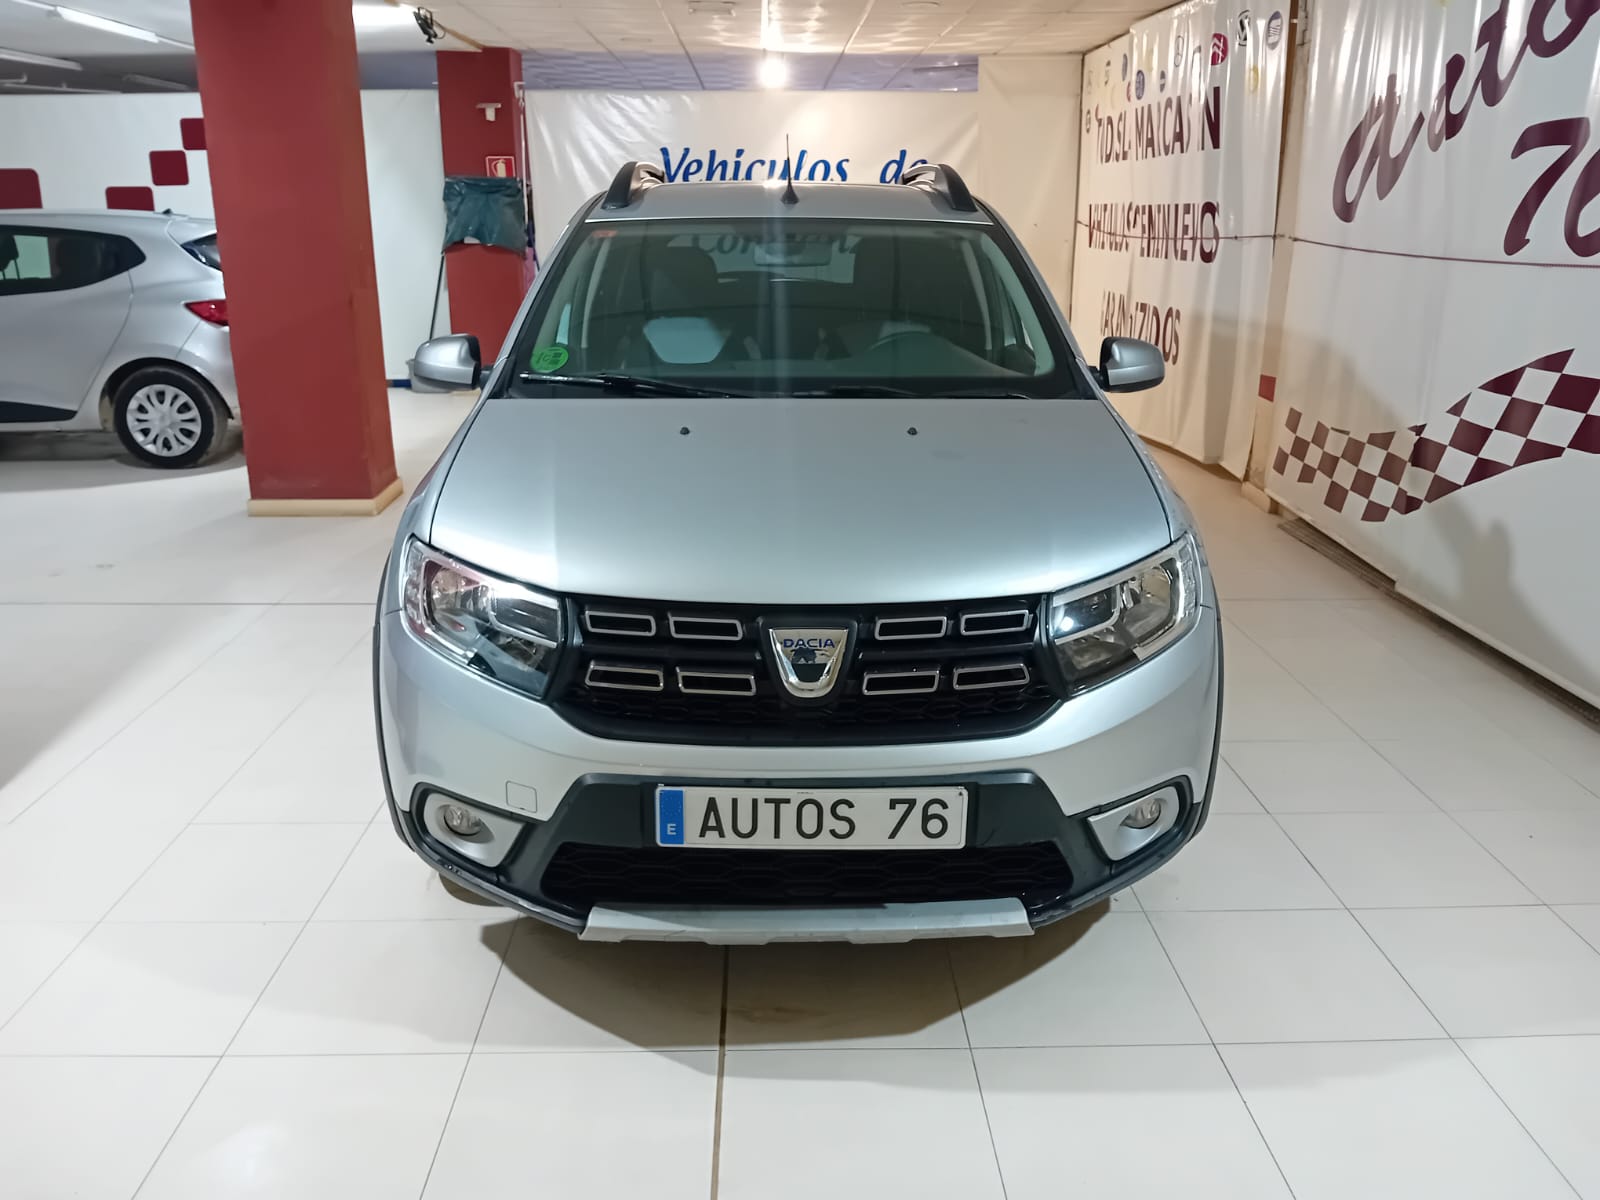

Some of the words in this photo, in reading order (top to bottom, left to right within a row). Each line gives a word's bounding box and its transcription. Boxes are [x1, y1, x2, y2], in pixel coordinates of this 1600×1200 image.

[880, 149, 928, 184] d
[783, 638, 835, 648] DACIA
[667, 823, 677, 835] E
[699, 796, 856, 839] AUTOS
[888, 797, 949, 839] 76
